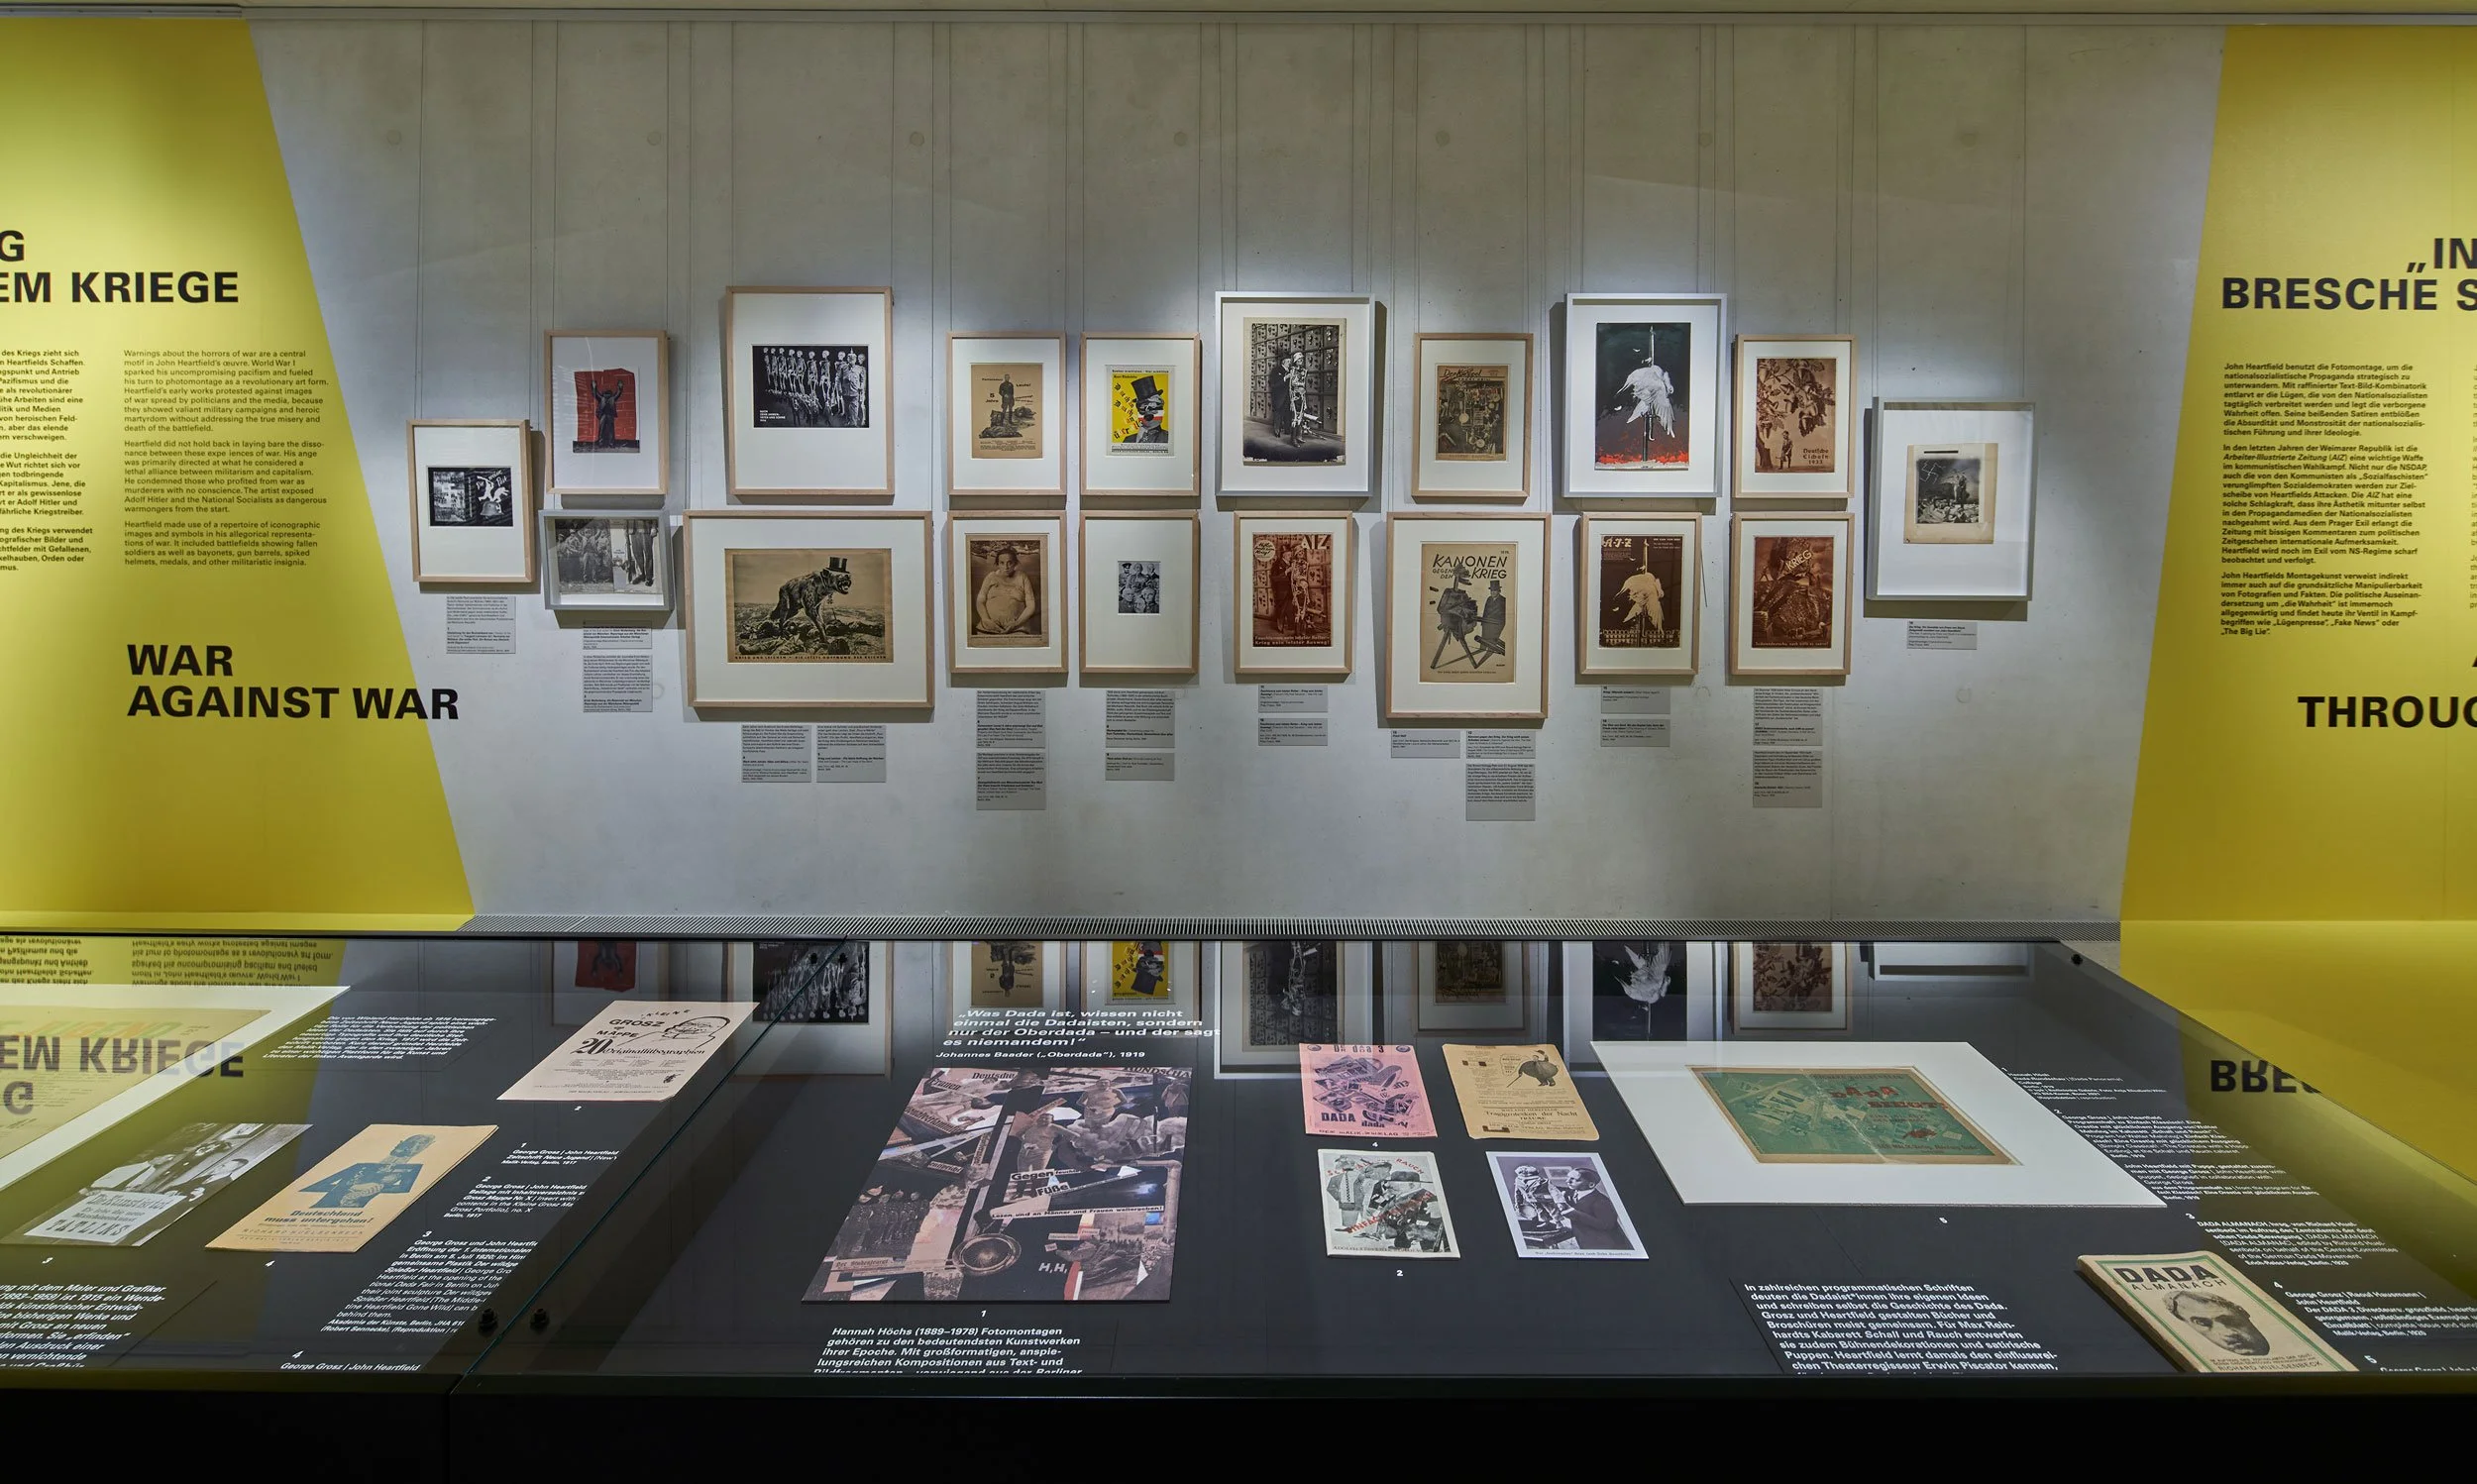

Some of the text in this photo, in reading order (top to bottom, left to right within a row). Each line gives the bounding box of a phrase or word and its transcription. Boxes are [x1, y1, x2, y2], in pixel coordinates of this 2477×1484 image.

[0, 230, 24, 262] G
[2406, 238, 2477, 273] „IN
[72, 271, 238, 303] KRIEGE
[2222, 277, 2437, 310] BRESCHE
[123, 350, 161, 358] Warnings
[2331, 363, 2384, 372] Fotomontage,
[1432, 554, 1507, 568] KANONEN
[1785, 549, 1812, 572] KRIEG
[1470, 567, 1507, 579] KRIEG
[127, 644, 233, 676] WAR
[127, 685, 459, 720] AGAINST WAR
[609, 1019, 665, 1027] GROSZ
[1184, 1029, 1221, 1037] sagt
[572, 1038, 614, 1055] 20
[1321, 1113, 1356, 1122] DADA
[1396, 1159, 1424, 1174] RAUCH
[1012, 1171, 1054, 1182] Gegen
[1037, 1182, 1068, 1196] Füße
[2113, 1265, 2219, 1284] DADA
[1821, 1284, 1923, 1292] programmatischen
[2131, 1279, 2227, 1291] ALMANACH
[1878, 1311, 1930, 1320] gestalten
[981, 1328, 1062, 1336] Fotomontagen
[827, 1338, 874, 1347] gehören
[852, 1348, 897, 1357] Epoche.
[923, 1348, 1016, 1358] großformatigen,
[1020, 1347, 1061, 1357] anspie-
[817, 1358, 892, 1368] lungsreichen
[895, 1358, 982, 1368] Kompositionen
[1041, 1358, 1064, 1366] und
[1792, 1361, 2058, 1371] chen Theaterregisseur Erwin Piscator kennen,
